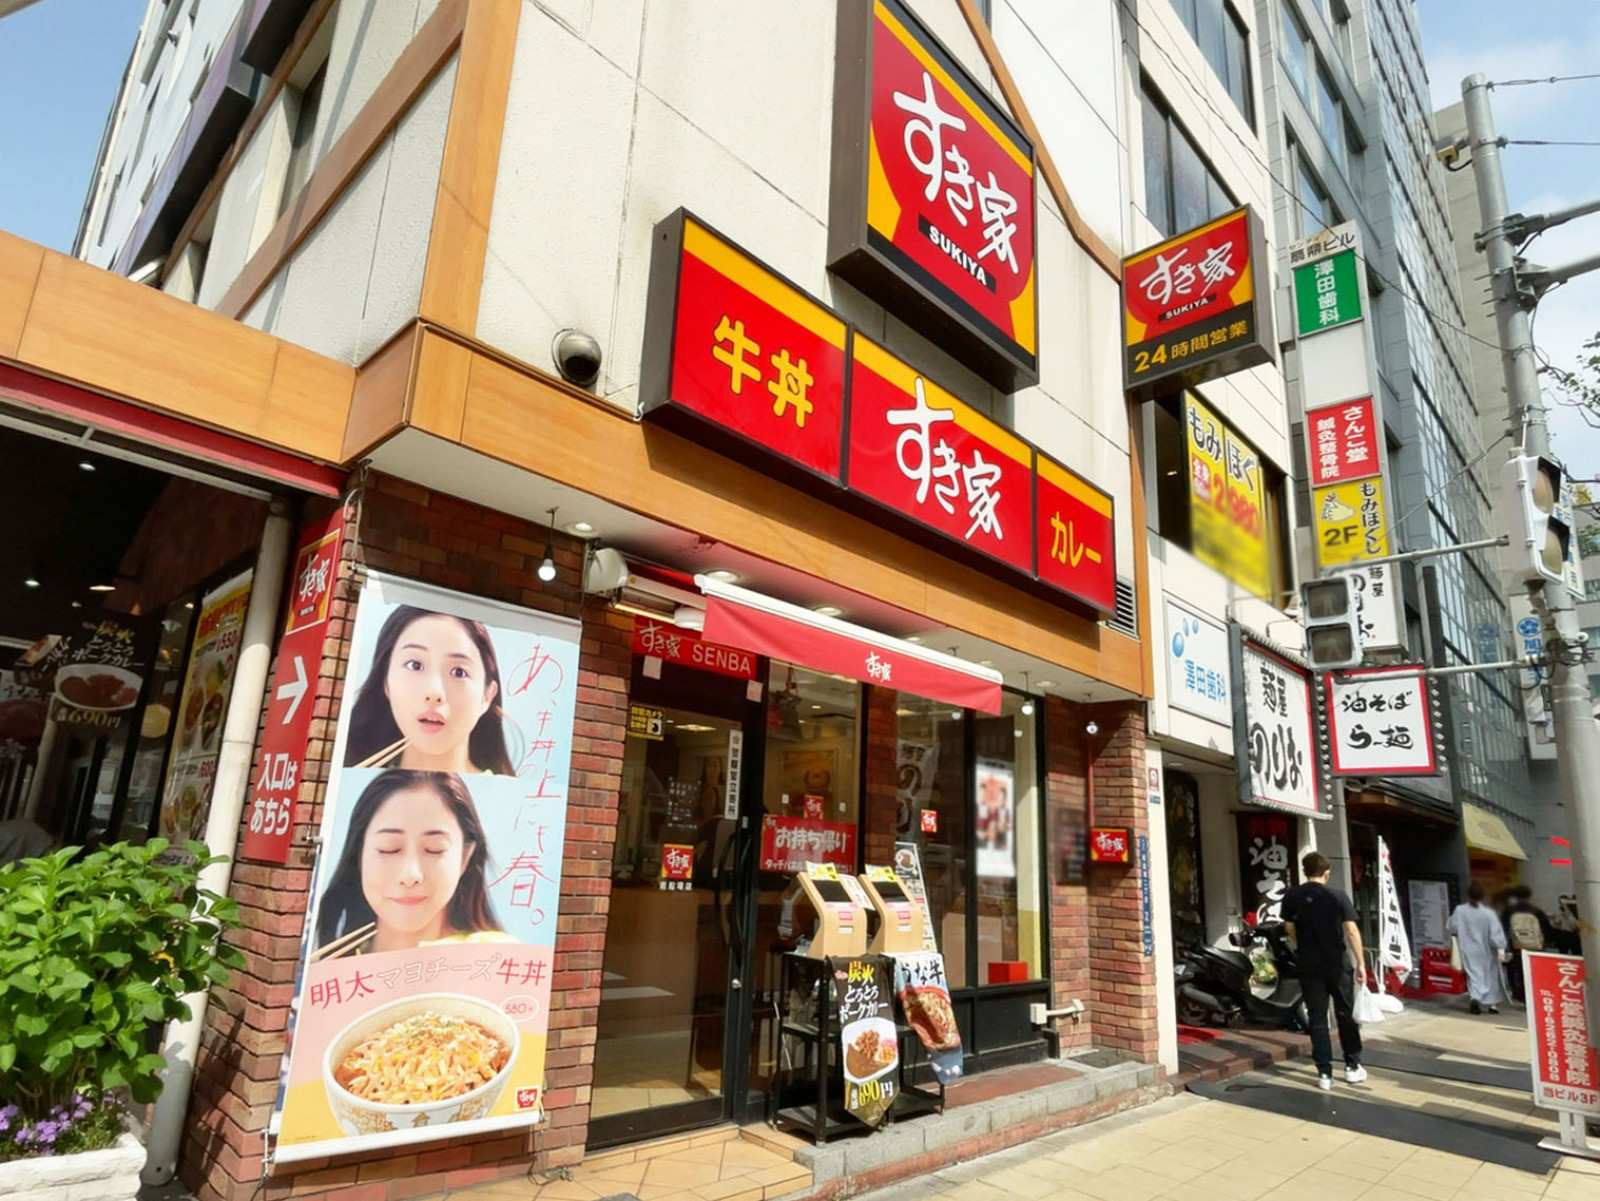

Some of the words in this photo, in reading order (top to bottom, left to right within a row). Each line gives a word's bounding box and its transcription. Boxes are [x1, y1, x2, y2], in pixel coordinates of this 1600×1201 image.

[893, 72, 1019, 274] すき家
[929, 224, 989, 286] SUKIYA
[1139, 241, 1236, 305] すき家
[1165, 297, 1209, 319] SUKIYA
[1134, 320, 1248, 373] 24時間営業
[712, 314, 814, 428] 牛丼
[1342, 405, 1369, 464] さんこ堂
[887, 377, 1004, 541] すき家
[1050, 510, 1102, 569] カレー
[1324, 525, 1358, 547] 2F
[299, 553, 331, 603] すき家
[639, 620, 682, 660] すき家
[692, 642, 752, 675] SENBA
[865, 651, 892, 682] すき家
[1341, 690, 1413, 713] 油そば
[257, 752, 298, 791] 入口は
[250, 796, 292, 836] あちら
[666, 847, 690, 870] すき家
[775, 826, 847, 854] お持ち帰り
[1097, 831, 1124, 853] すき家
[310, 953, 547, 1010] 明太マヨチーズ牛丼
[848, 961, 875, 986] 炭火
[901, 960, 943, 985] うな牛
[839, 1001, 889, 1023] ポークカレー
[844, 985, 879, 1003] とろとろ
[858, 1079, 894, 1106] 690円
